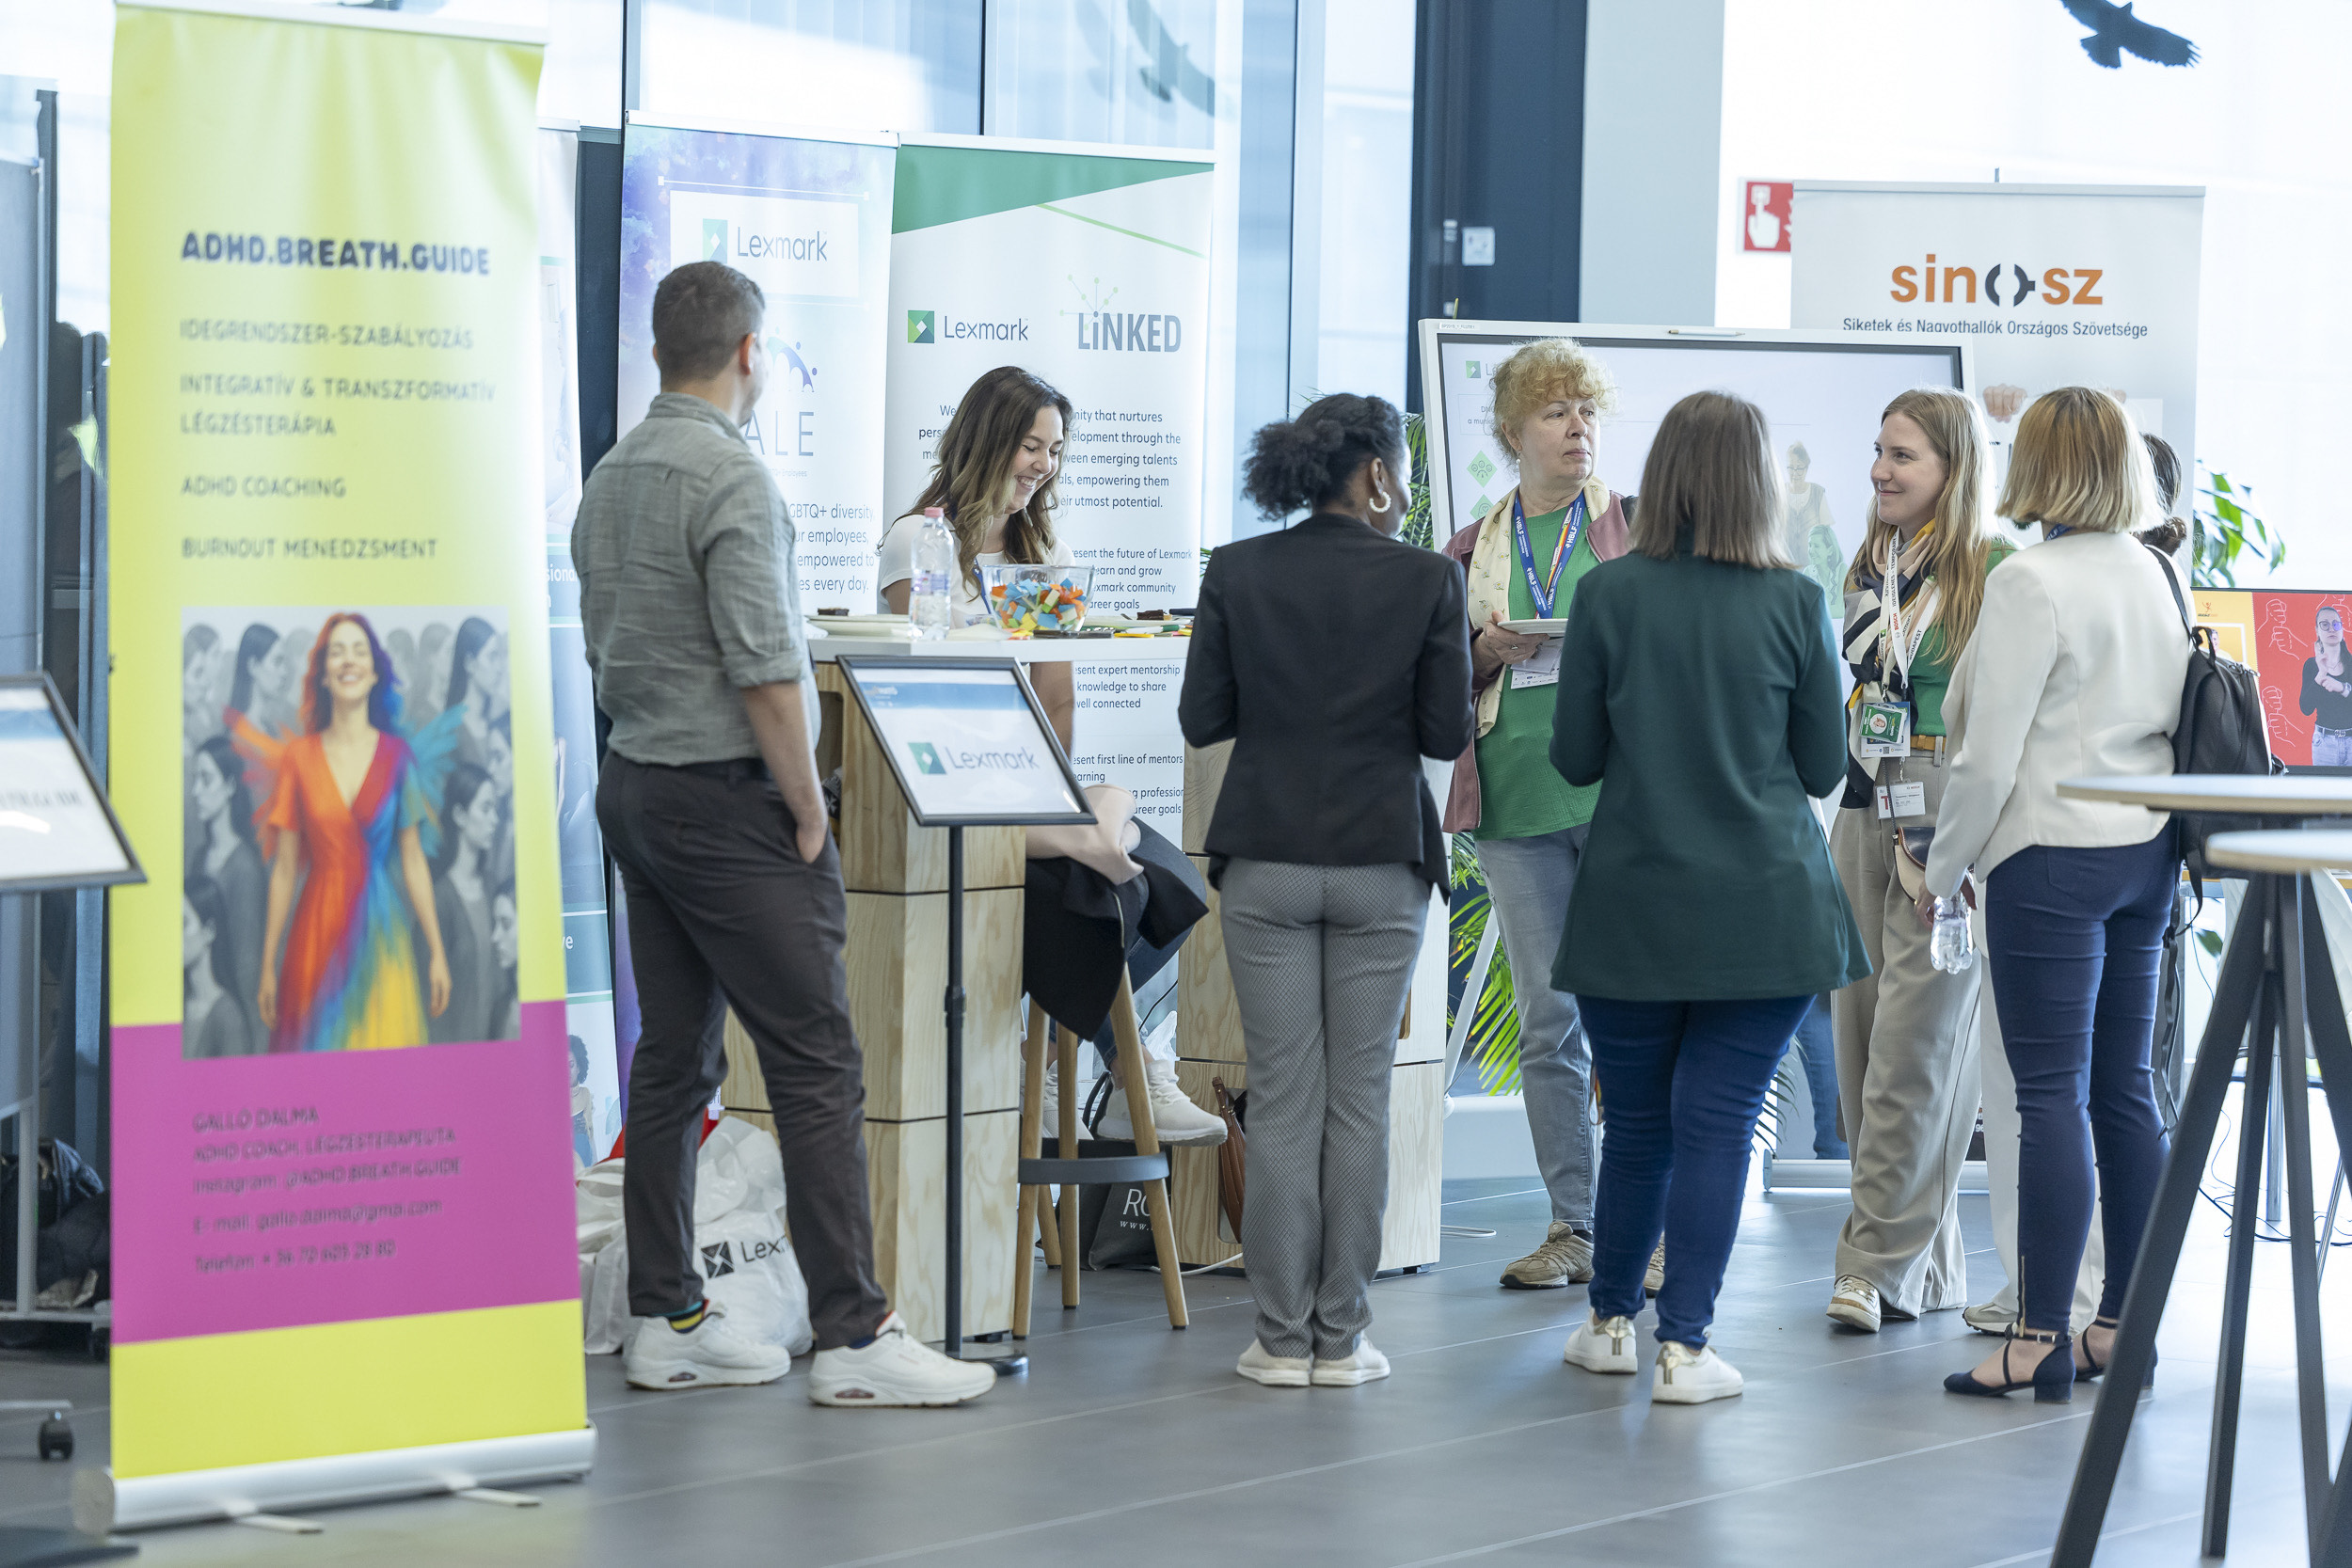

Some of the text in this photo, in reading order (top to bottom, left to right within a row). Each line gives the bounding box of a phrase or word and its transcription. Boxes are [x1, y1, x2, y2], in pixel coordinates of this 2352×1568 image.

[738, 227, 827, 261] Lexmark
[181, 231, 490, 276] ADHD.BREATH.GUIDE
[180, 318, 473, 349] IDEGRENDSZER-SZABÁLYOZÁS
[944, 315, 1028, 341] Lexmark
[1843, 317, 1892, 332] Siketek
[1897, 318, 1912, 332] és
[2007, 319, 2069, 338] Országos
[2073, 321, 2148, 340] Szövetsége
[180, 371, 294, 399] INTEGRATÍV
[180, 410, 337, 436] LÉGZÉSTERÁPIA
[1074, 408, 1092, 423] nity
[1094, 409, 1117, 421] that
[1120, 411, 1163, 423] nurtures
[743, 410, 815, 457] ALE
[1072, 431, 1120, 445] elopment
[1121, 432, 1163, 446] through
[1166, 433, 1182, 445] the
[1090, 453, 1140, 467] emerging
[1143, 453, 1178, 466] talents
[181, 475, 346, 499] ADHD COACHING
[1059, 473, 1169, 488] als, empowering them
[1060, 495, 1164, 510] eir utmost potential.
[789, 503, 827, 519] GBTQ+
[182, 537, 438, 560] BURNOUT MENEDZSMENT
[1073, 547, 1192, 560] esent the future of Lexmark
[798, 551, 875, 570] empowered to
[1095, 565, 1163, 578] earn and grow
[814, 579, 845, 594] every
[848, 575, 869, 594] day.
[1126, 582, 1177, 594] community
[1089, 599, 1140, 611] areer goals
[1075, 664, 1181, 677] sent expert mentorship
[1076, 681, 1167, 693] knowledge to share
[1092, 698, 1141, 708] connected
[945, 746, 1040, 770] Lexmark
[1097, 754, 1116, 765] first
[1118, 753, 1135, 765] line
[1136, 753, 1147, 765] of
[1149, 753, 1184, 765] mentors
[1073, 771, 1105, 784] earning
[1158, 803, 1182, 816] goals
